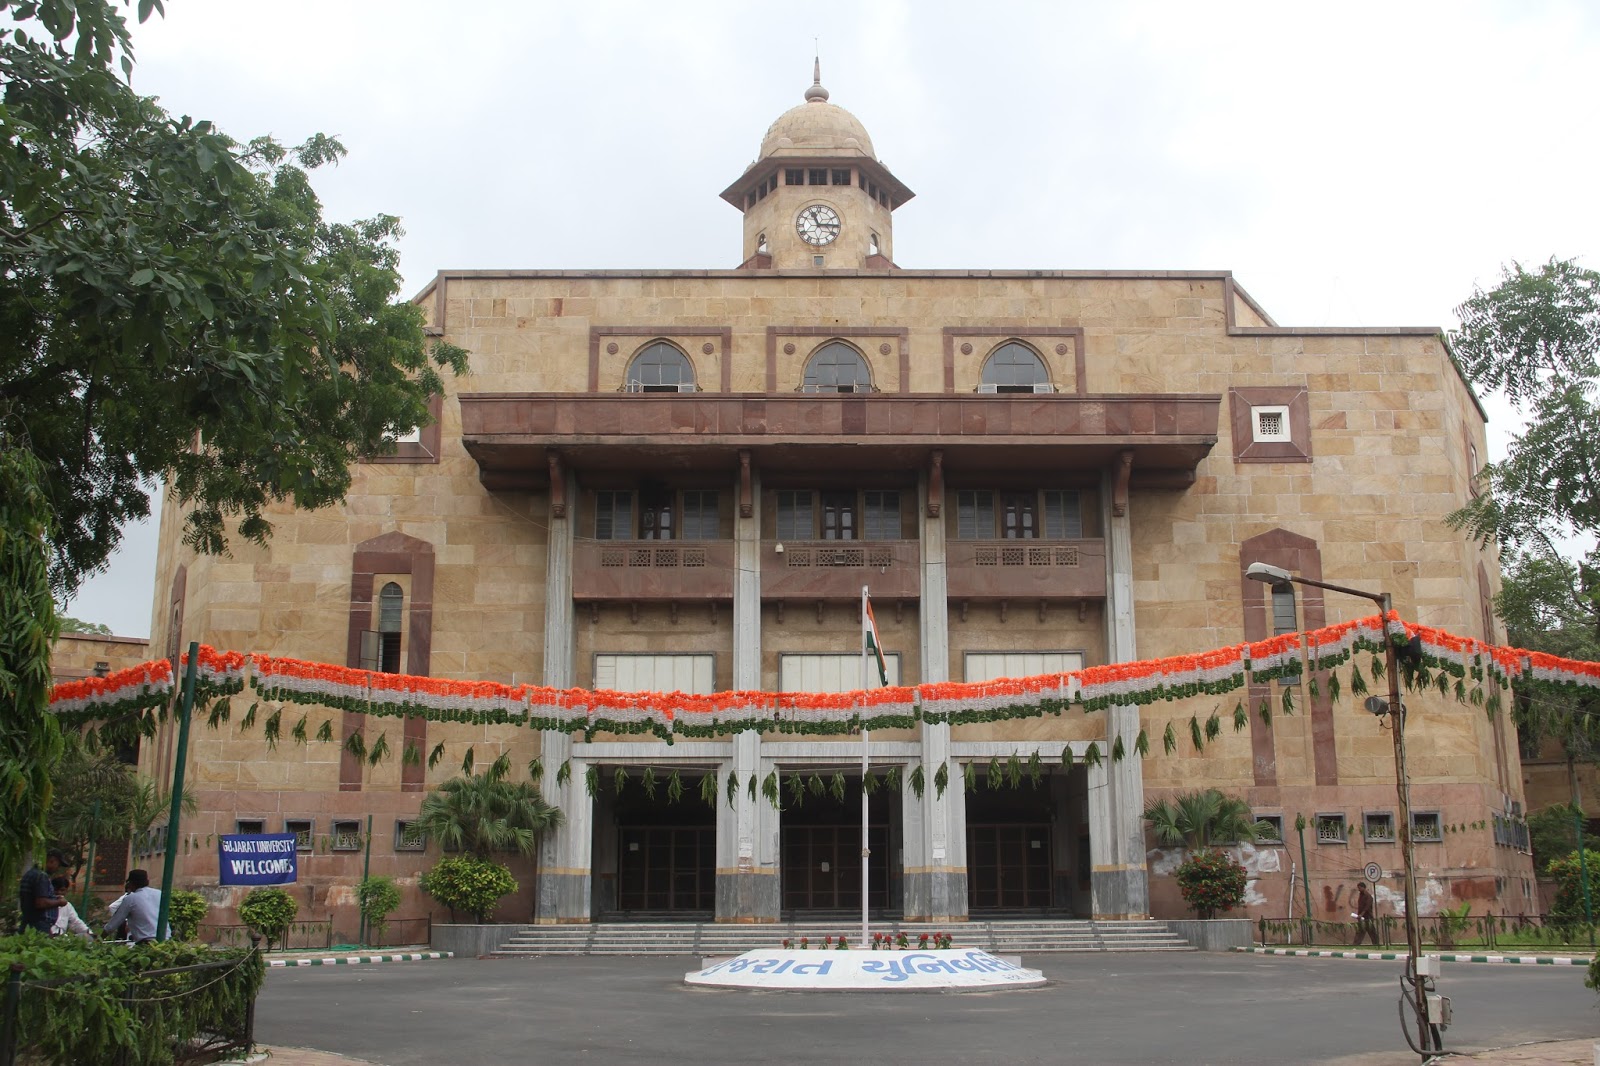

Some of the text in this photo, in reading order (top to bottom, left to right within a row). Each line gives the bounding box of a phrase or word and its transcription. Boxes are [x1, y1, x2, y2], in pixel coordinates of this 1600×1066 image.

[222, 839, 295, 853] GUJARAT UNIVERSITY
[231, 858, 294, 875] WELCOMES
